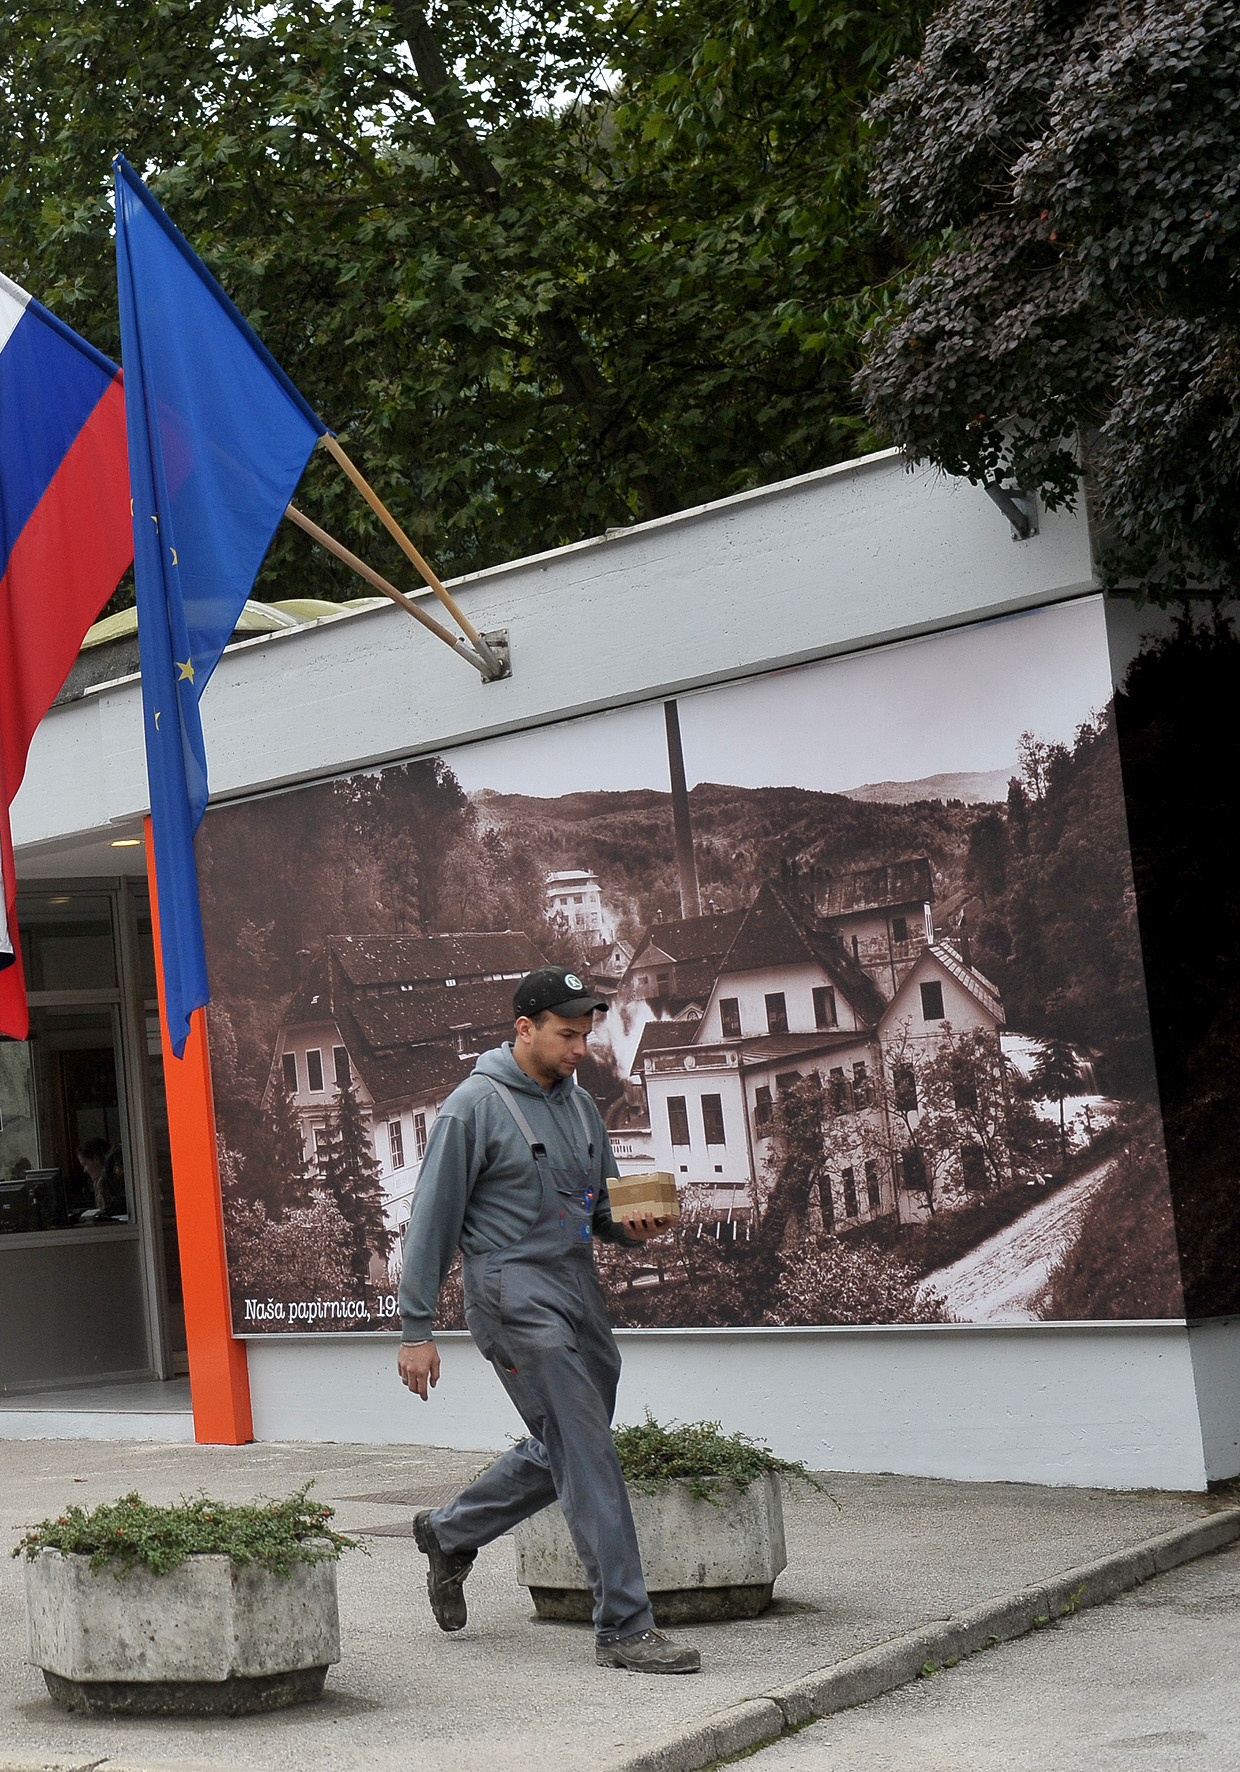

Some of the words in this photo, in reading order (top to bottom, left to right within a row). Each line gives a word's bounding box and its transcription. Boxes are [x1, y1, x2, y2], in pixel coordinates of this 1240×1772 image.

[244, 1297, 286, 1320] Naša
[287, 1297, 371, 1324] papirnica,
[376, 1295, 401, 1318] 19
